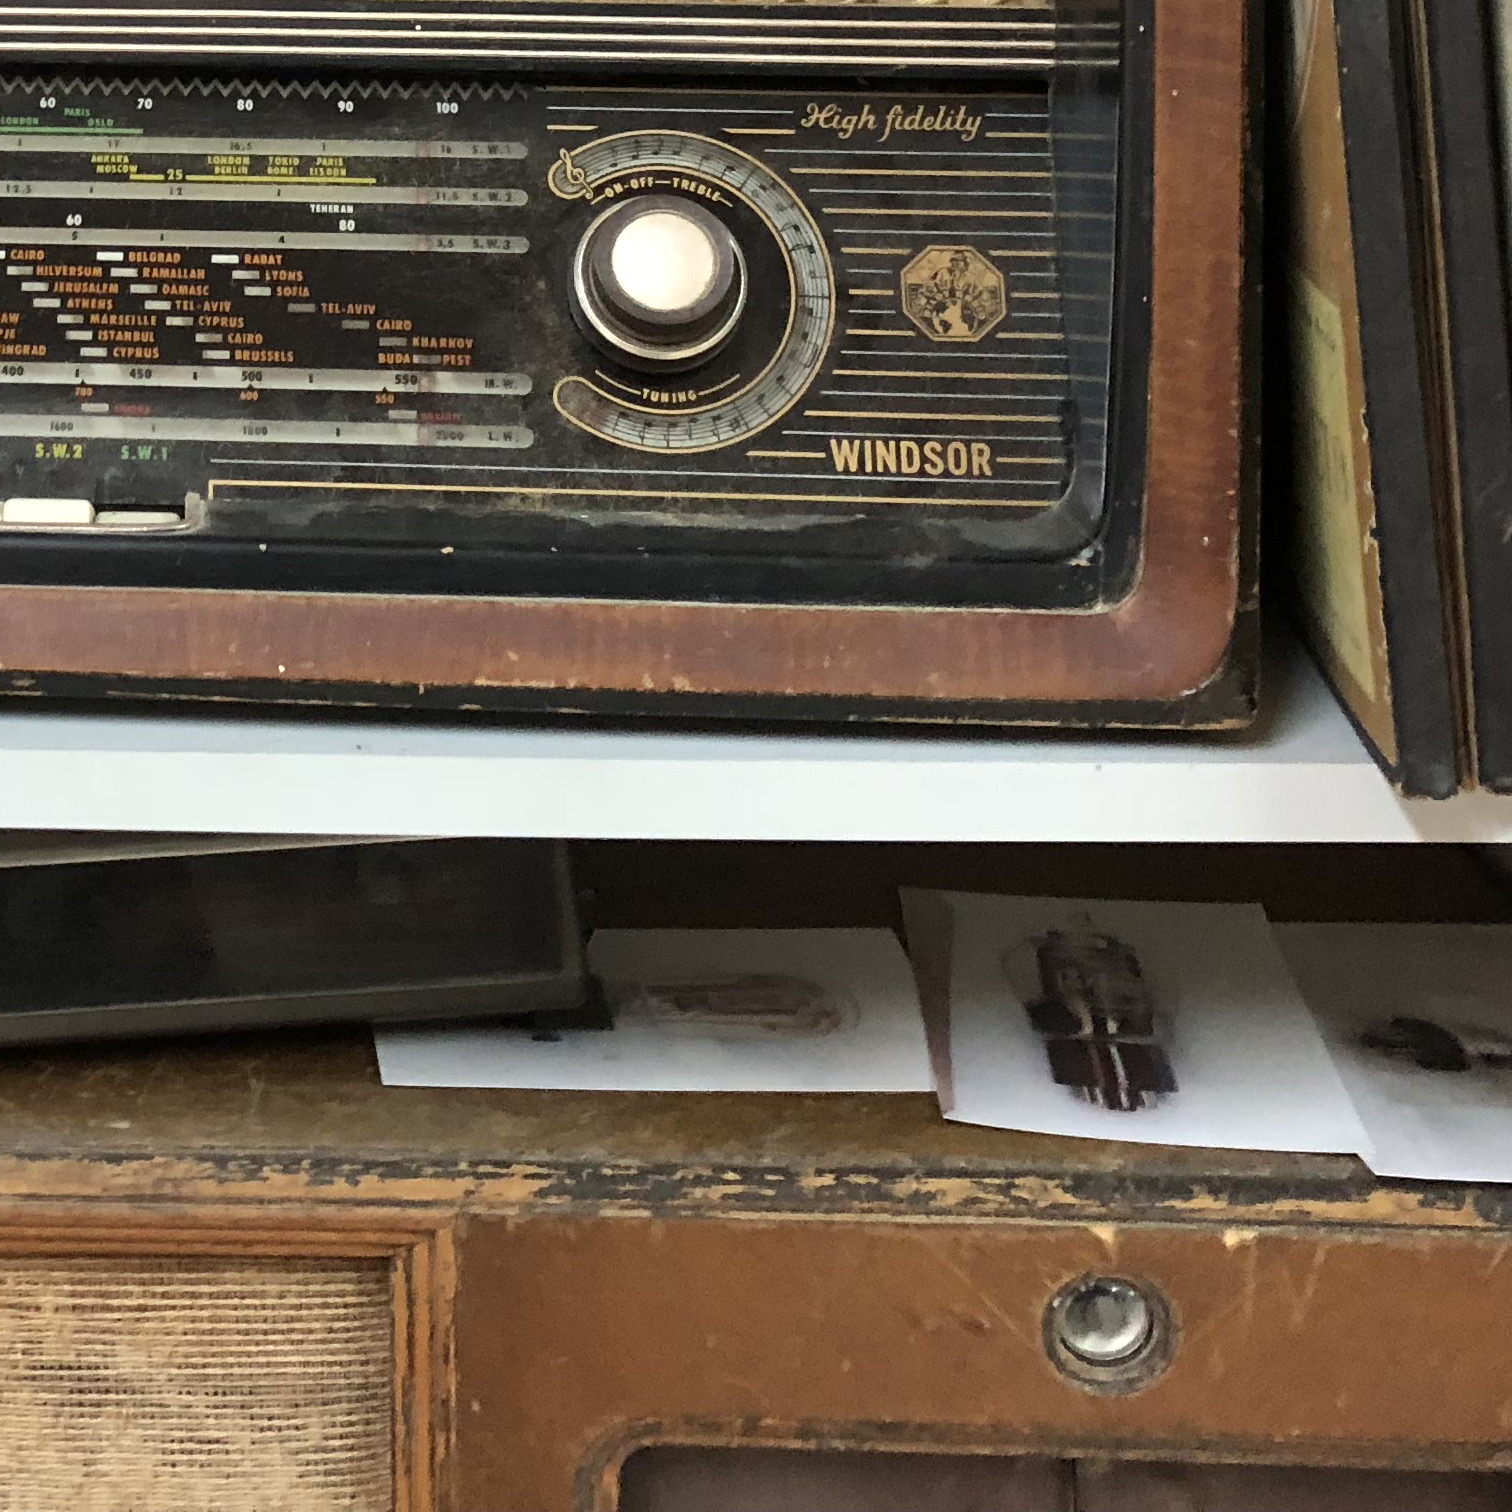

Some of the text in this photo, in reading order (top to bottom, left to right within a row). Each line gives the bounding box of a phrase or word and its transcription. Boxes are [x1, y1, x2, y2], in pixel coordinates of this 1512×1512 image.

[40, 97, 56, 108] 60
[137, 98, 152, 109] 70
[237, 99, 253, 111] 80
[338, 101, 354, 112] 90
[436, 102, 459, 114] 100
[64, 108, 90, 117] PARIS
[0, 117, 38, 125] LONDON
[88, 118, 113, 127] OSLO
[800, 103, 982, 142] High fidelity
[91, 155, 129, 163] ANKARA
[208, 157, 250, 165] LONDON
[316, 158, 344, 166] PARIS
[96, 165, 138, 173] MOSCOW
[167, 170, 183, 180] 25
[310, 205, 353, 213] TEHERAN
[66, 214, 82, 226] 60
[339, 220, 355, 231] 80
[72, 231, 78, 240] 5
[278, 236, 285, 244] 4
[10, 250, 44, 260] CAIRO
[128, 252, 181, 263] BELGRAD
[244, 254, 283, 265] RABAT
[36, 266, 103, 277] HILVERSUM
[143, 268, 205, 279] RAMALLAH
[265, 270, 304, 281] LYONS
[53, 282, 118, 294] JERUSALEM
[162, 284, 209, 296] DAMASC
[276, 286, 310, 297] SOFIA
[67, 299, 113, 310] ATHENS
[321, 304, 376, 314] TEL-AVIV
[90, 314, 157, 325] MARSEILLE
[199, 316, 244, 327] CYPRUS
[376, 320, 412, 330] CAIRO
[98, 331, 155, 342] ISTANBUL
[227, 333, 263, 344] CAIRO
[412, 337, 474, 348] KHARKOV
[113, 347, 159, 358] CYPRUS
[235, 350, 294, 362] BRUSSELS
[378, 354, 472, 366] BUDA PEST
[1, 366, 24, 376] 400
[130, 368, 152, 378] 450
[241, 371, 262, 381] 500
[395, 374, 417, 385] 550
[240, 391, 258, 401] 600
[375, 394, 395, 404] 550
[642, 388, 697, 402] TUNING
[35, 443, 83, 458] S.W.2
[121, 445, 168, 461] S.W.1
[830, 439, 992, 476] WINDSOR
